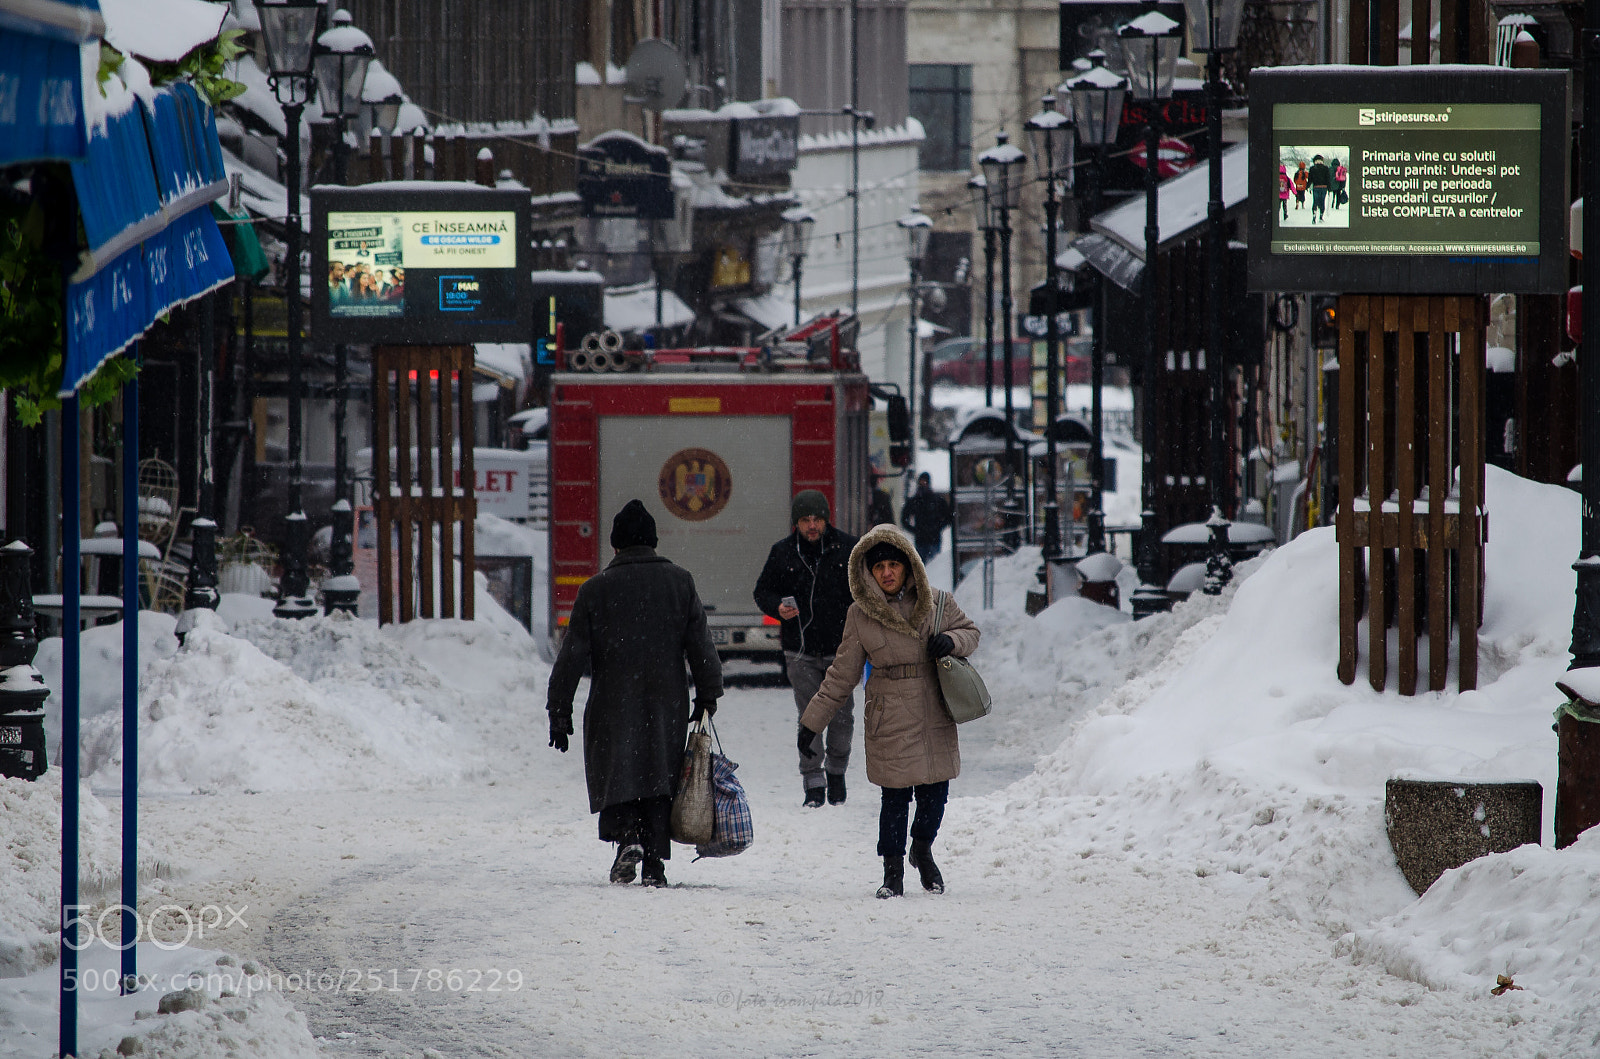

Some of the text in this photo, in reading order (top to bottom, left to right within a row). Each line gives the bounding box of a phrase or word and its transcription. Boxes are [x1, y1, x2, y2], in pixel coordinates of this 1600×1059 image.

[1376, 111, 1449, 124] stiripesurse.ro
[1362, 150, 1496, 162] Primaria vine cu solutii
[1362, 164, 1521, 178] pentru parinti: Unde-si pot
[1362, 178, 1493, 192] lasa copiii pe perioada
[1361, 192, 1498, 206] suspendarii cursurilor /
[1361, 206, 1524, 218] Lista COMPLETA a centrelor
[411, 219, 509, 233] CE ÎNSEAMNĂ
[440, 236, 467, 244] OSCAR
[458, 247, 487, 255] ONEST
[1333, 243, 1370, 252] documente
[1371, 243, 1407, 252] incendiare.
[1445, 244, 1527, 253] WWW.STIRIPESURSE.RO
[452, 282, 480, 291] 7 MAR
